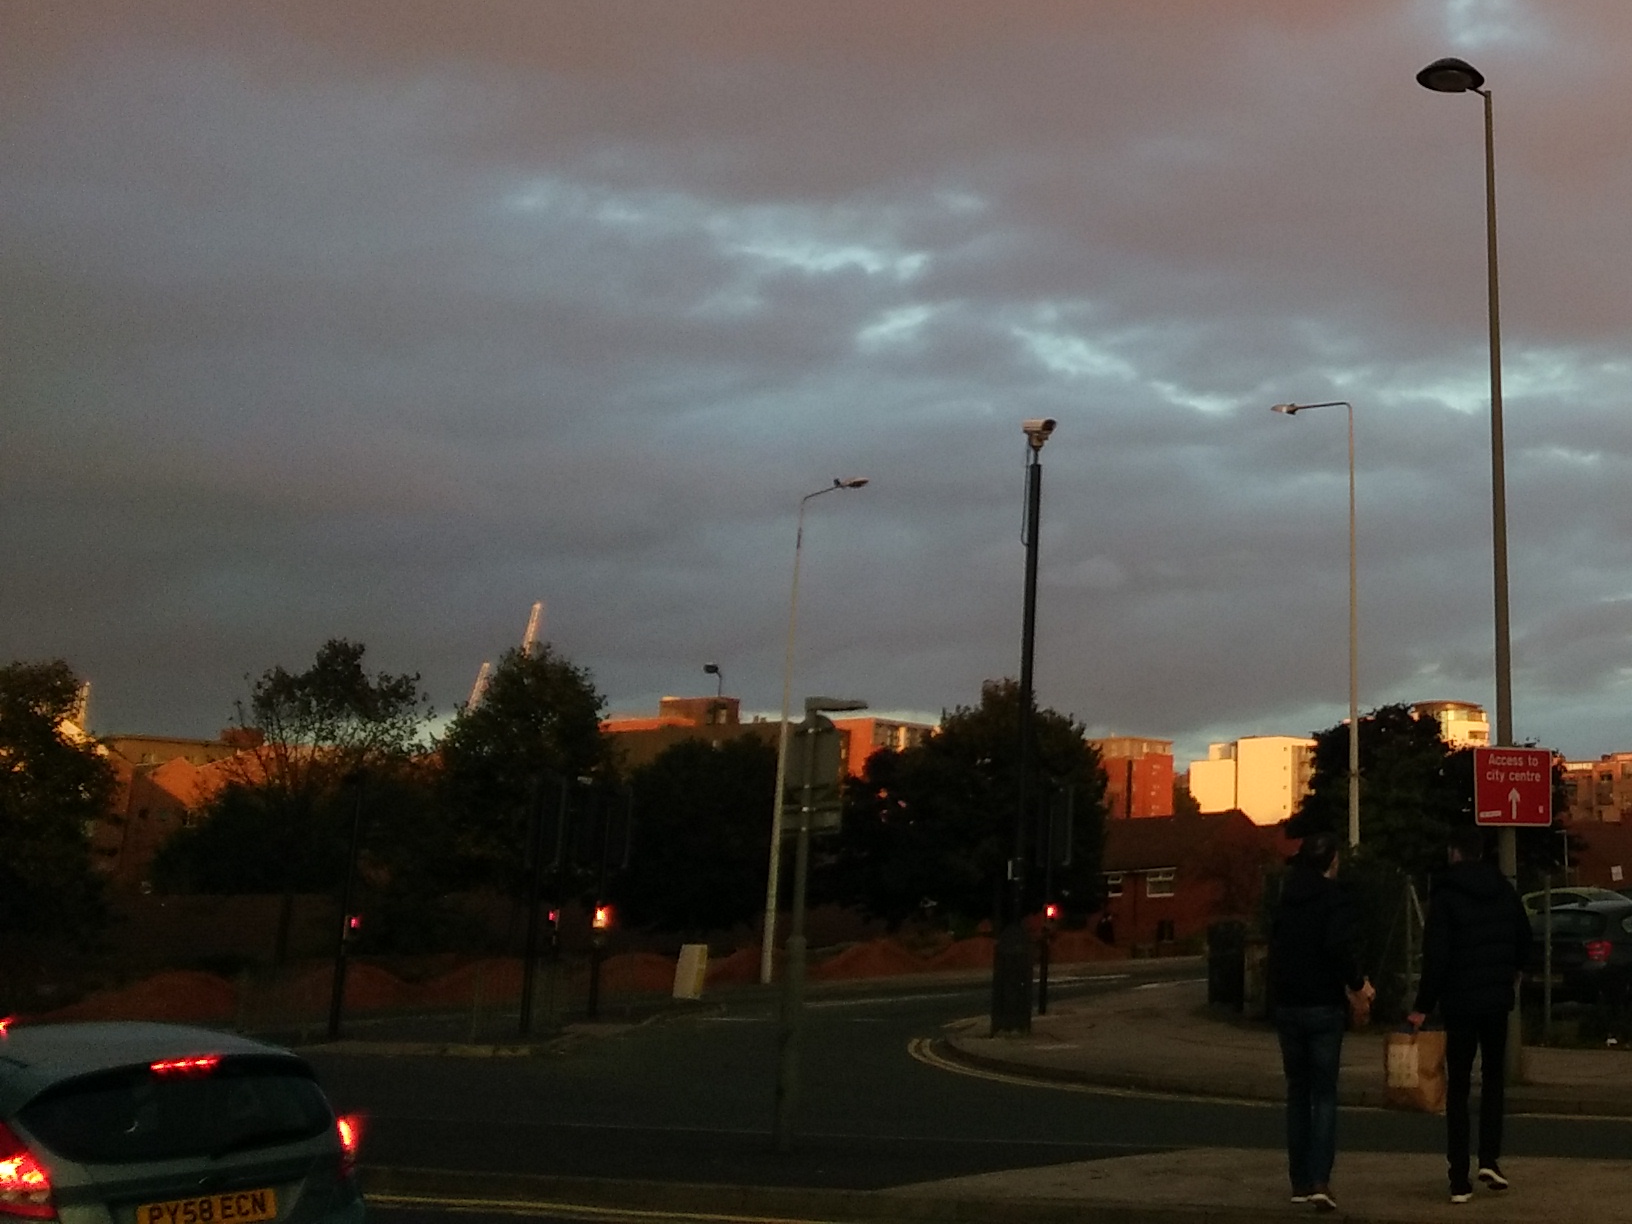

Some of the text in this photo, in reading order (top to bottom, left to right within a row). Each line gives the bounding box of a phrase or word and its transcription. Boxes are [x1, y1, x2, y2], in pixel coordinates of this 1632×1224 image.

[1488, 753, 1539, 767] Access to
[1486, 769, 1541, 783] city centre
[149, 1191, 268, 1224] PY58 ECN
